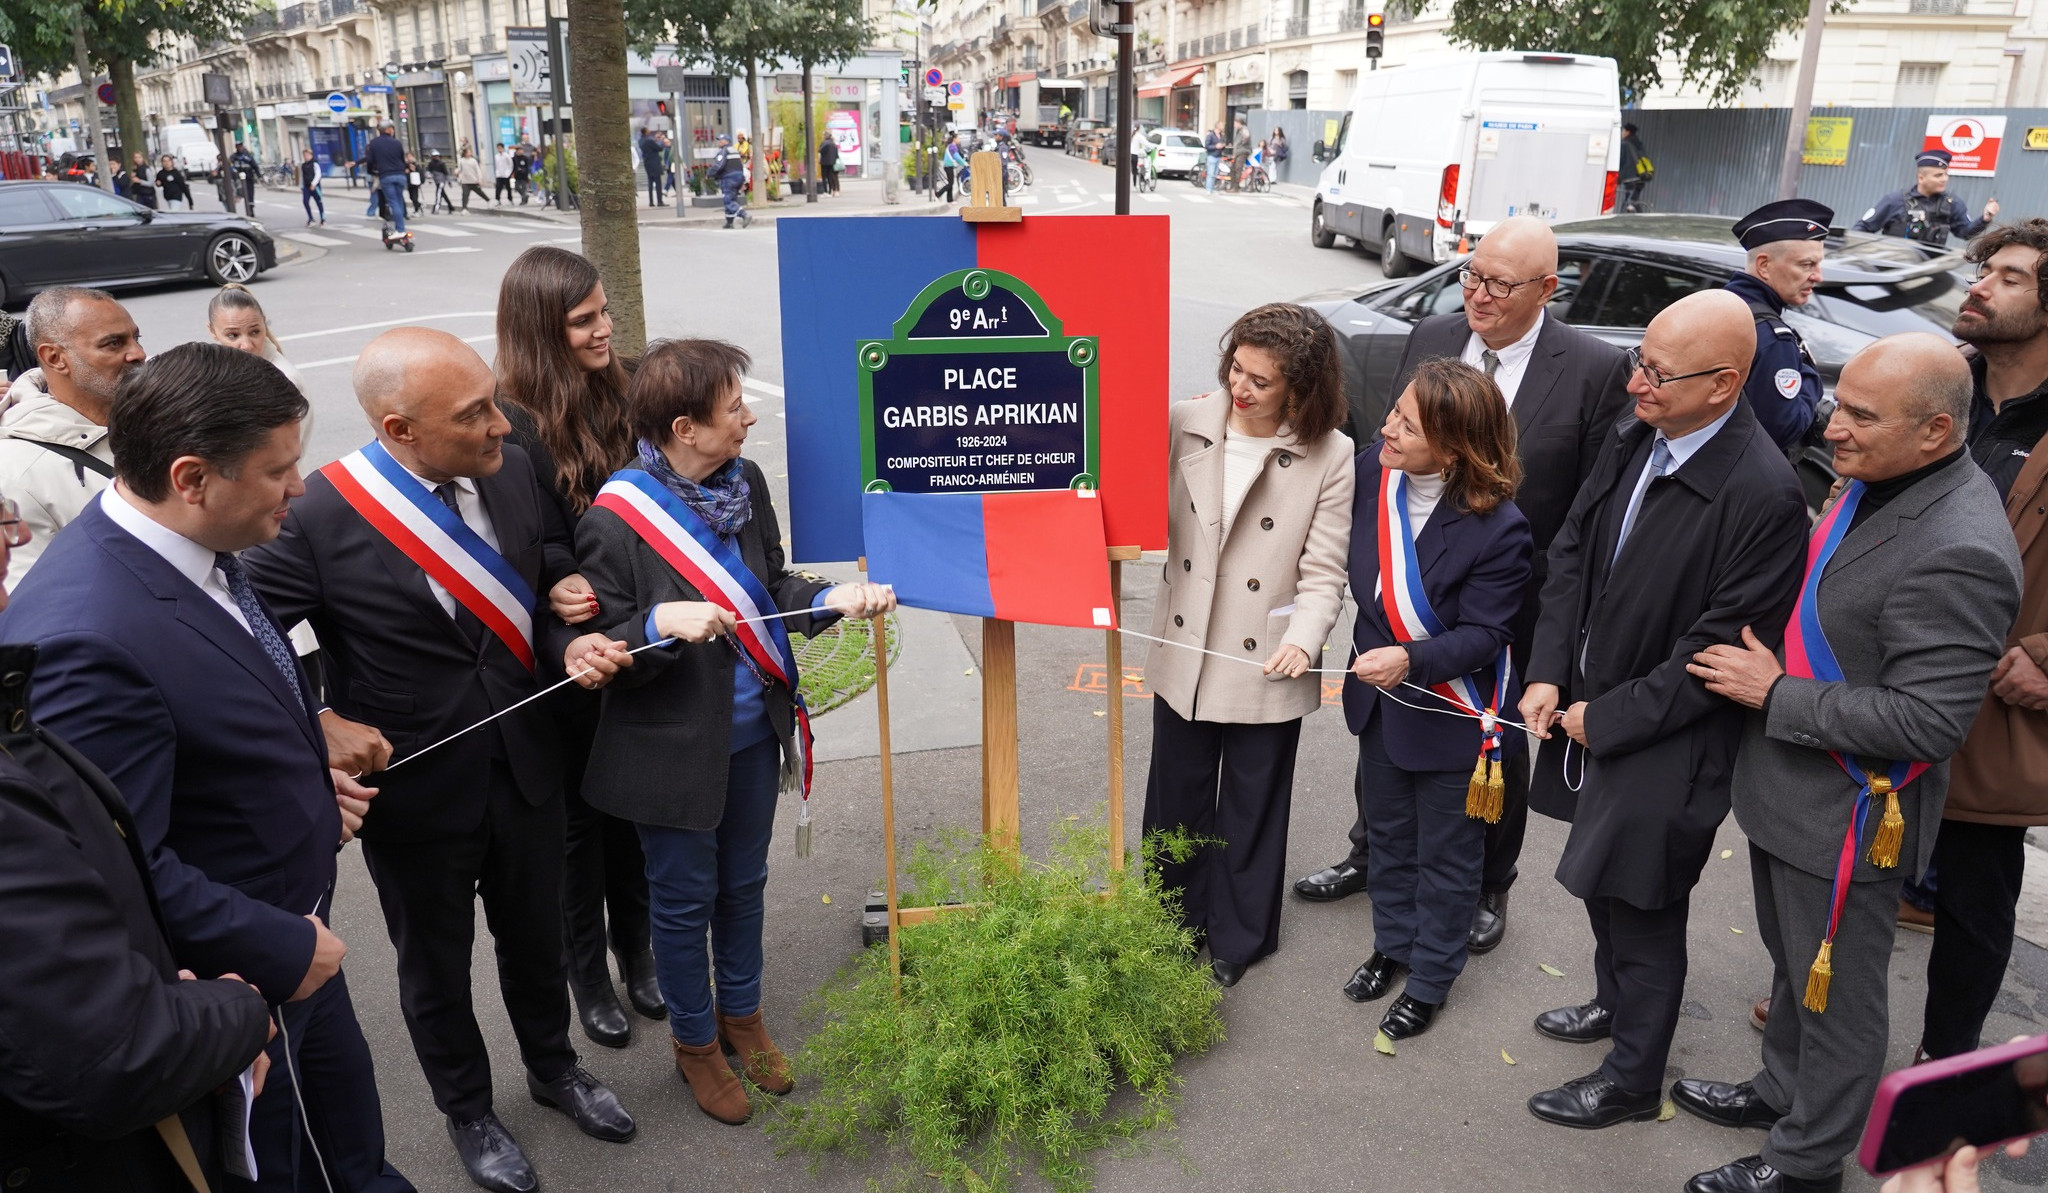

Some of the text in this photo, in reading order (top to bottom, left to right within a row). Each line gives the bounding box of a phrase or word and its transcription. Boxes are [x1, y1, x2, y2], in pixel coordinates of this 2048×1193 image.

[847, 86, 858, 94] 10
[950, 308, 970, 330] 9e
[944, 367, 1017, 390] PLACE
[883, 403, 1078, 428] GARBIS APRIKIAN
[956, 435, 1007, 448] 1926-2024
[887, 452, 1076, 469] COMPOSITEUR ET CHEF DE CHŒUR
[930, 470, 1035, 487] FRANCO-ARMÉNIEN
